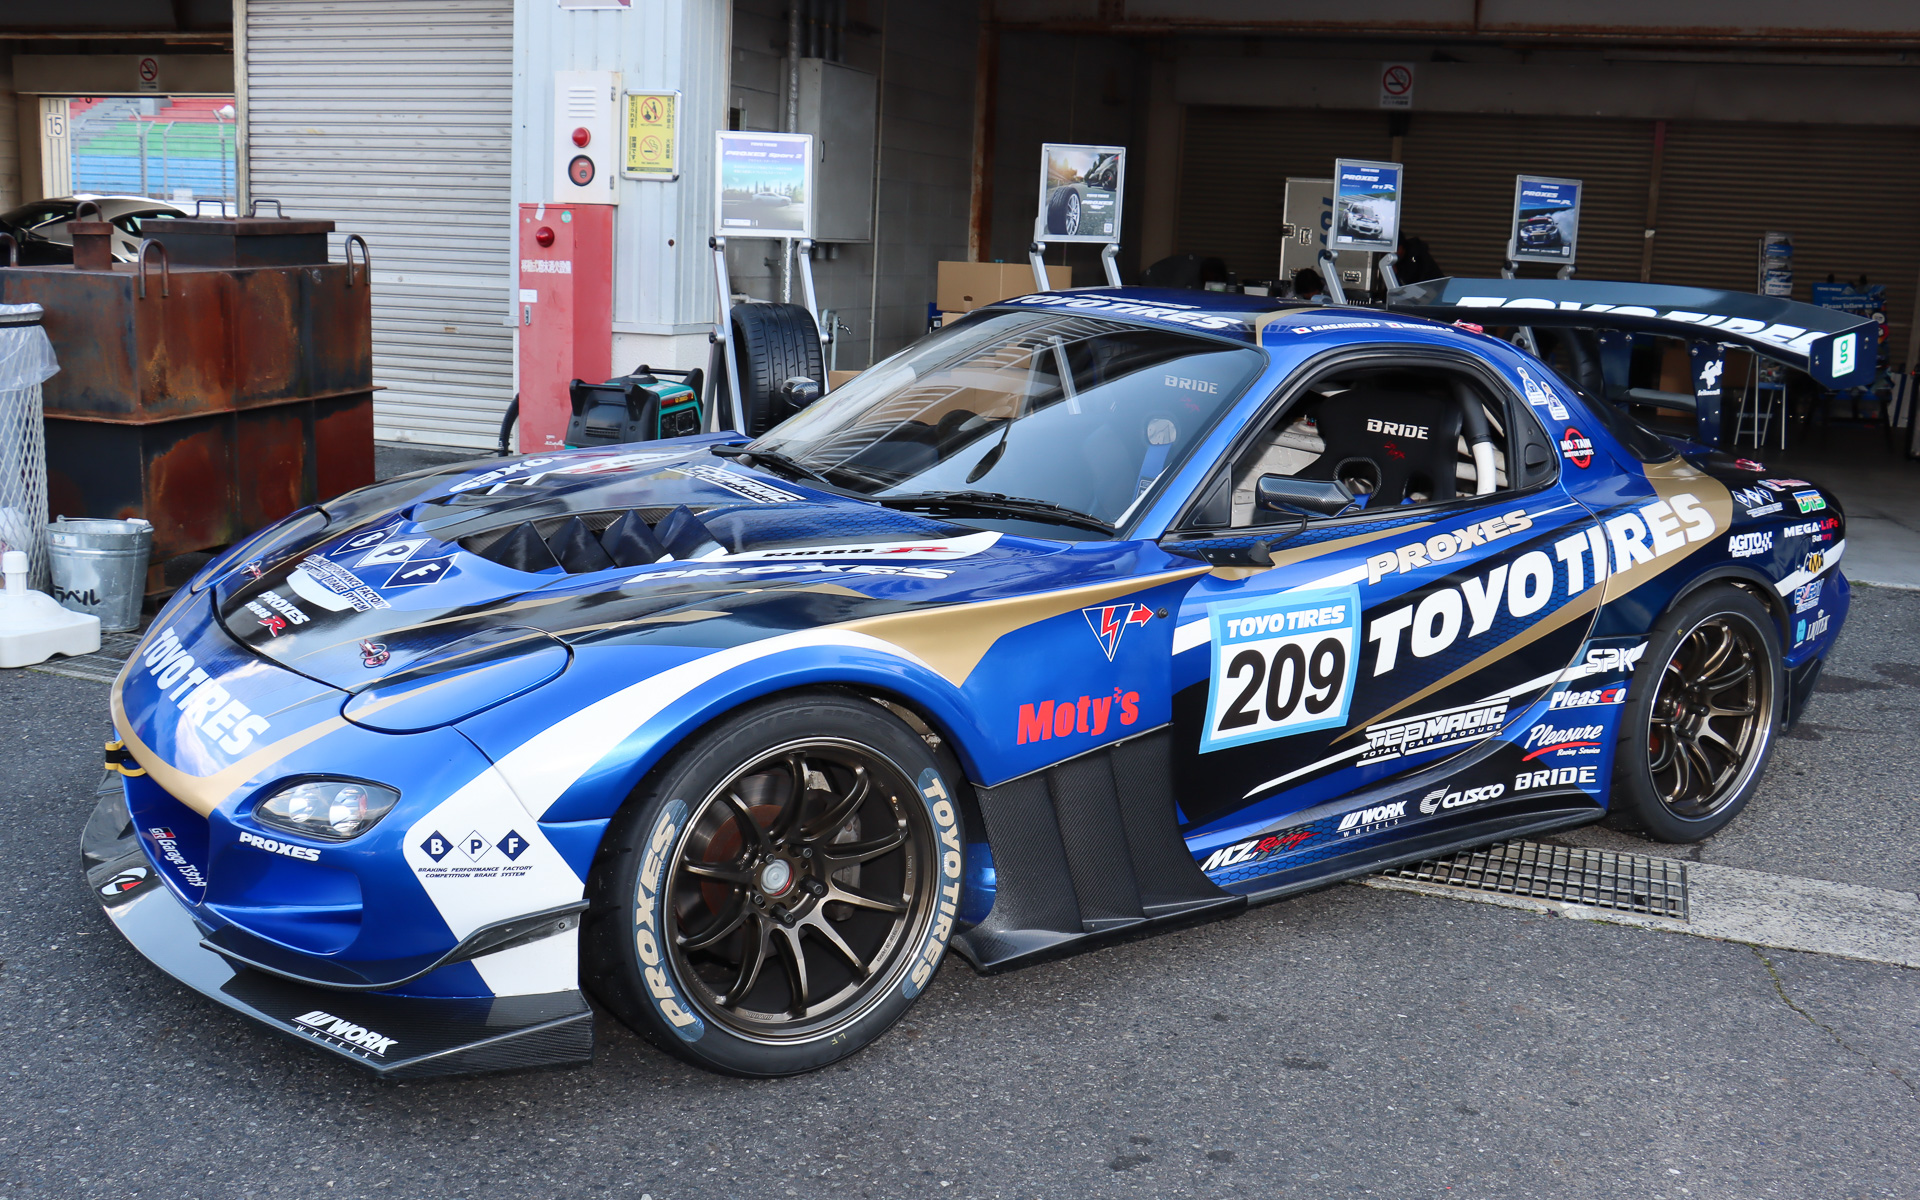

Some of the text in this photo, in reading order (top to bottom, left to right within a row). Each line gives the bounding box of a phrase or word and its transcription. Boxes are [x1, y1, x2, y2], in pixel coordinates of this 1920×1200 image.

[47, 116, 63, 136] 15
[1342, 173, 1380, 183] PROXES
[1522, 190, 1559, 199] PROXES
[1097, 302, 1243, 329] TIRES
[1164, 374, 1219, 396] BRIDE
[1366, 418, 1430, 440] BRIDE
[1365, 509, 1534, 586] PROXES
[1727, 531, 1763, 552] AGITO
[350, 532, 441, 580] B P F
[622, 562, 957, 585] PROXES
[1368, 493, 1717, 678] TOYO TIRES
[258, 590, 311, 626] PROXES
[1227, 604, 1347, 639] TOYO TIRES
[1586, 647, 1635, 674] SPK
[143, 626, 272, 756] TOYO TIRES
[1217, 637, 1347, 732] 209
[1016, 686, 1141, 746] Moty's
[1361, 723, 1503, 759] TOTAL CAR PRODUCE
[1523, 723, 1604, 750] Pleasure
[1514, 765, 1598, 791] BRIDE
[1442, 783, 1505, 809] CUSCO
[1360, 800, 1408, 825] WORK
[1343, 818, 1399, 838] WHEELS
[157, 839, 188, 865] Garage
[239, 831, 322, 863] PROXES
[911, 777, 962, 990] TOYO TIRES
[635, 812, 696, 1029] PROXES
[295, 1026, 370, 1060] WHEELS
[326, 1020, 398, 1055] WORK
